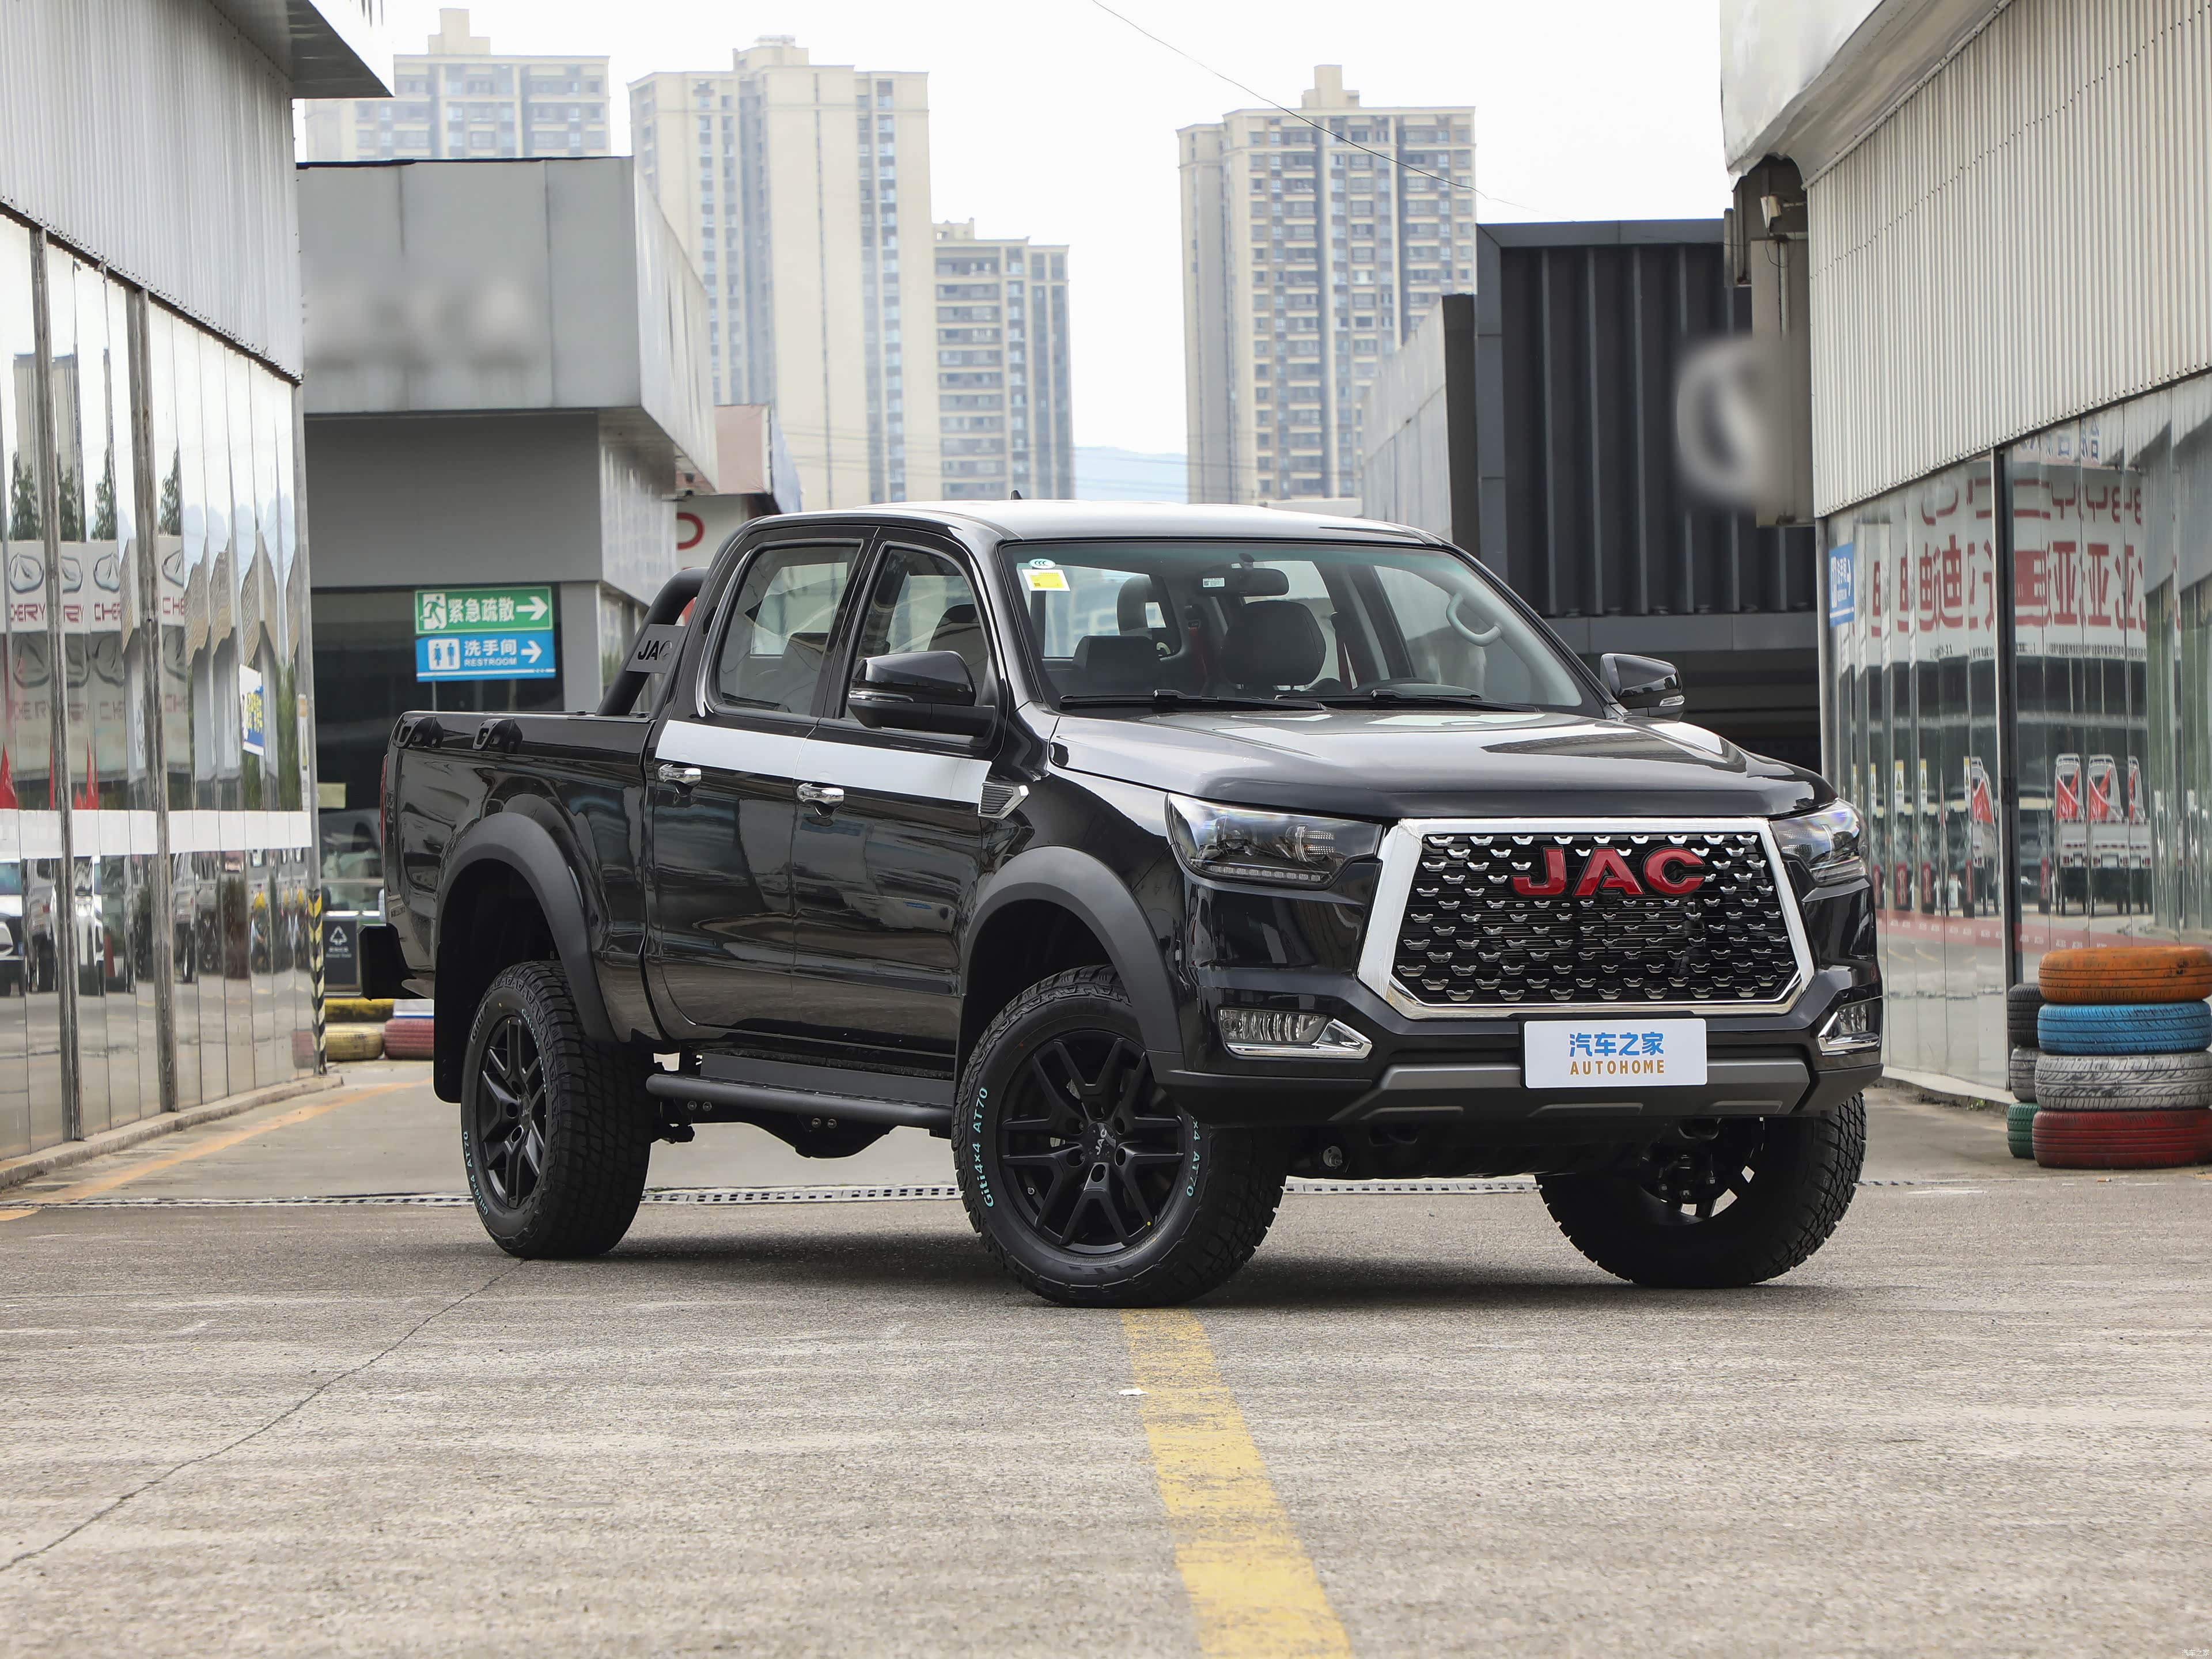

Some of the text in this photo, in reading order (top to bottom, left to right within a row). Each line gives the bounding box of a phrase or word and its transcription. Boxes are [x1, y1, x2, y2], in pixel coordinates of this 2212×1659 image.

[464, 639, 517, 656] 洗手间
[638, 640, 672, 661] JAC
[464, 657, 517, 666] RESTROOM
[1512, 846, 1705, 896] JAC
[1569, 1032, 1664, 1057] 汽车之家
[1570, 1059, 1665, 1075] AUTOHOME
[463, 1130, 473, 1168] AT70
[972, 1086, 994, 1207] Giti4x4 AT70
[1095, 1129, 1107, 1156] JAC
[1187, 1150, 1200, 1197] AT70
